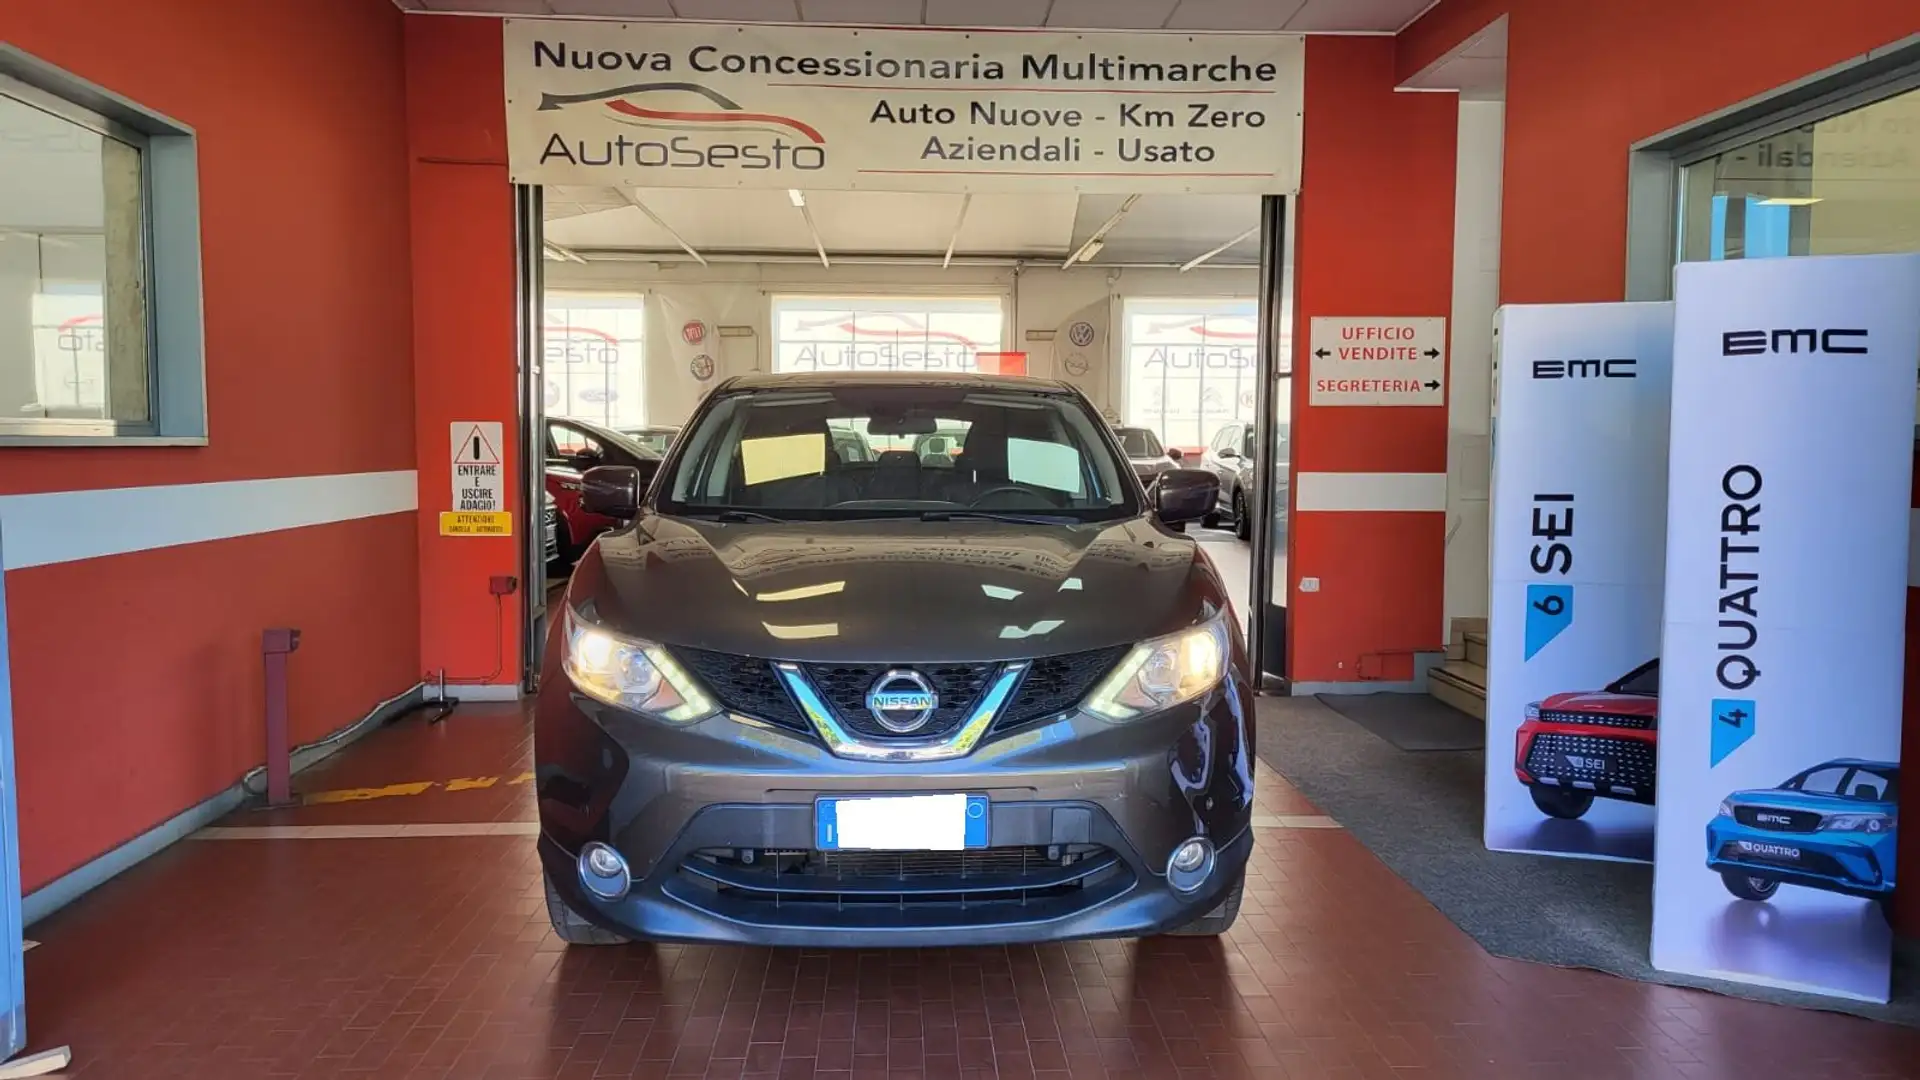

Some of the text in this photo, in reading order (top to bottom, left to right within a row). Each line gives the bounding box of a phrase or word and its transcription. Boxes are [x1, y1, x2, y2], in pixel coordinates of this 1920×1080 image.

[534, 41, 1277, 83] Nuova Concessionaria Multimarche
[869, 100, 956, 125] Auto
[970, 101, 1083, 128] Nuove
[1119, 103, 1175, 128] Km
[1187, 103, 1266, 129] Zero
[539, 133, 826, 171] AutoSesto
[920, 136, 1081, 163] Aziendali
[1117, 138, 1216, 164] Usato
[1342, 327, 1415, 340] UFFICIO
[1338, 347, 1417, 360] VENDITE
[1316, 379, 1421, 392] SEGRETERIA
[457, 465, 496, 476] ENTRARE
[475, 477, 480, 487] E
[461, 488, 493, 499] USCIRE
[460, 500, 496, 510] ADAGIO!
[1530, 494, 1574, 616] 6 SEI
[1716, 464, 1763, 729] 4 QUATTRO
[873, 696, 931, 707] NISSAN
[1585, 758, 1605, 770] SEI
[1753, 843, 1800, 858] QUATTRO
